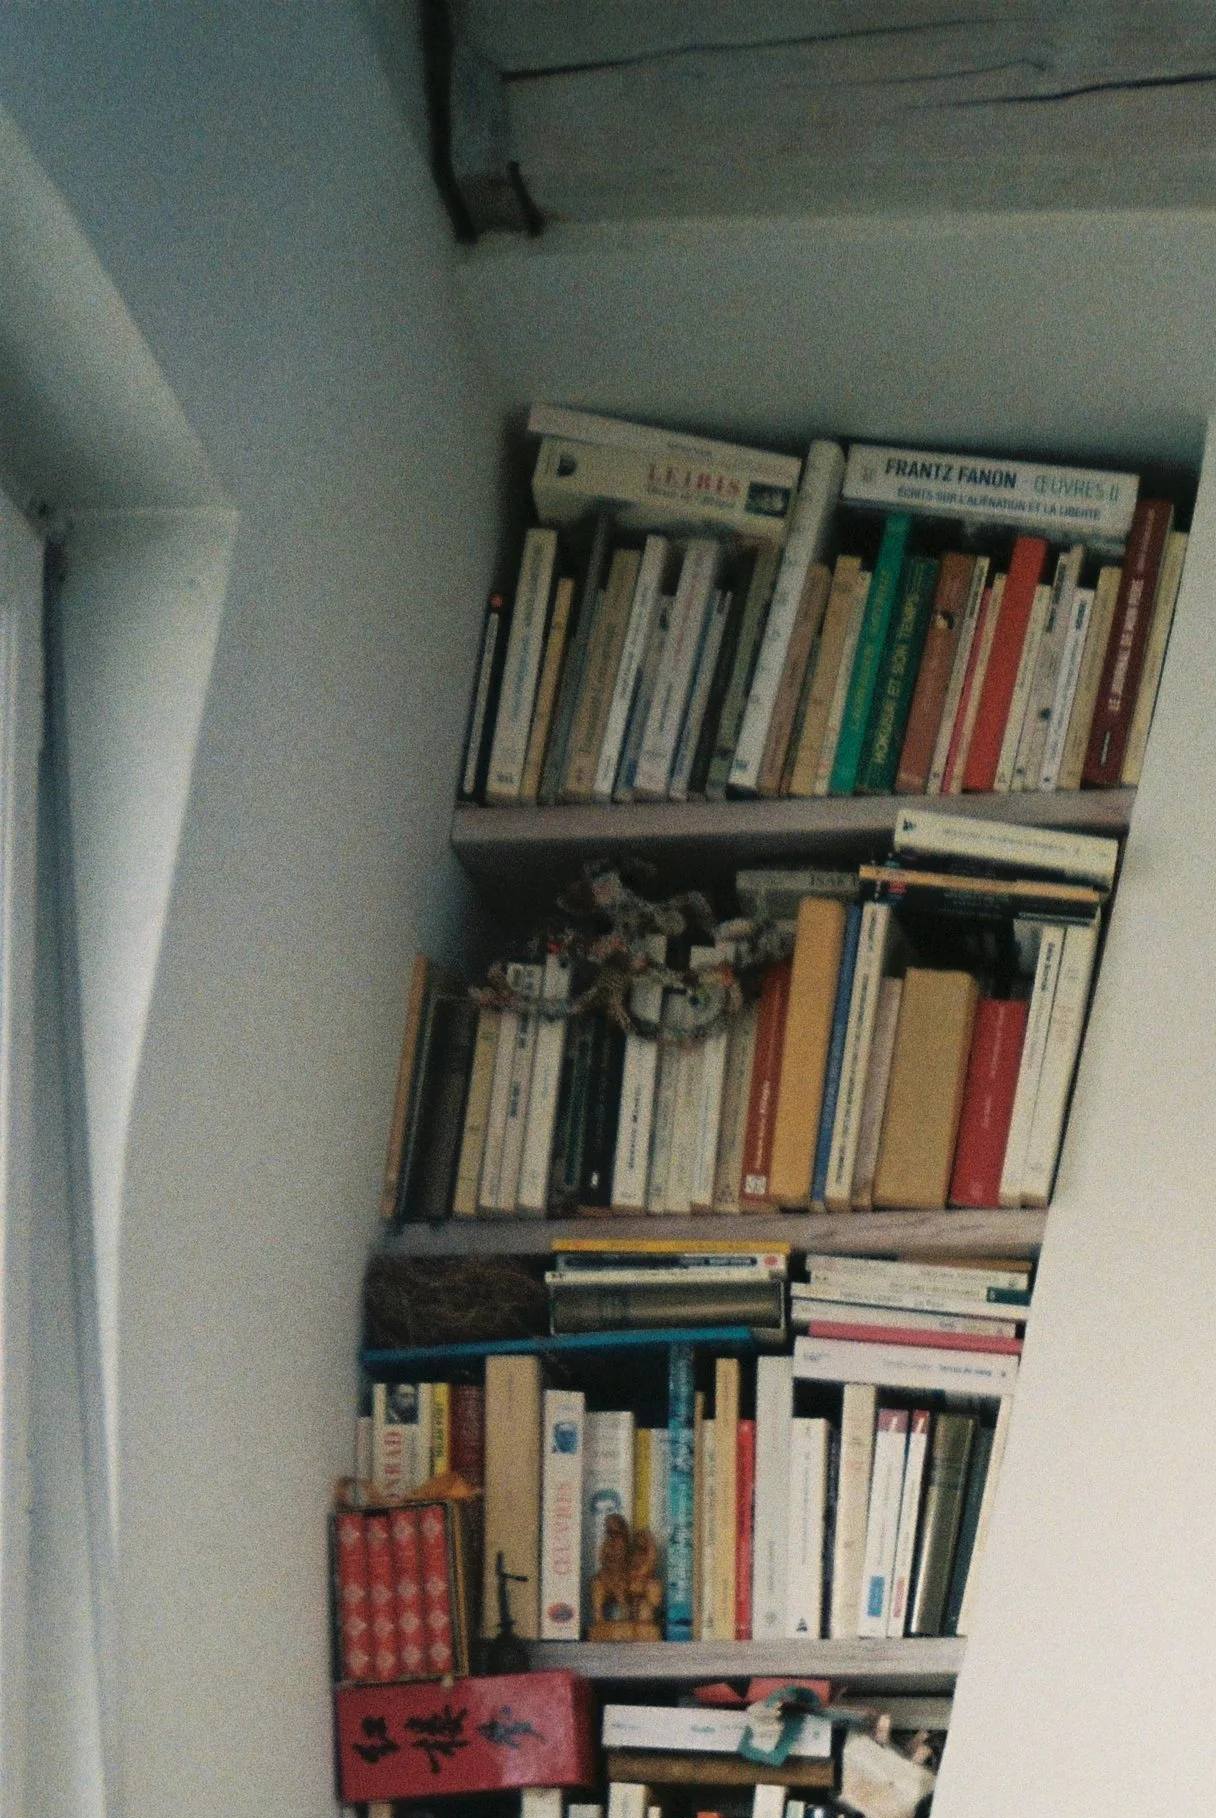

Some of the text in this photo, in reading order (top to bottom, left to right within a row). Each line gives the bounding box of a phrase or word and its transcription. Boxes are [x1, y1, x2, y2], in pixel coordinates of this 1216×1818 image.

[646, 462, 742, 497] LEIRIS
[884, 454, 953, 482] FRANTZ
[956, 464, 1017, 489] FANON
[871, 591, 919, 765] HOKUSAI ET SON TEMPS
